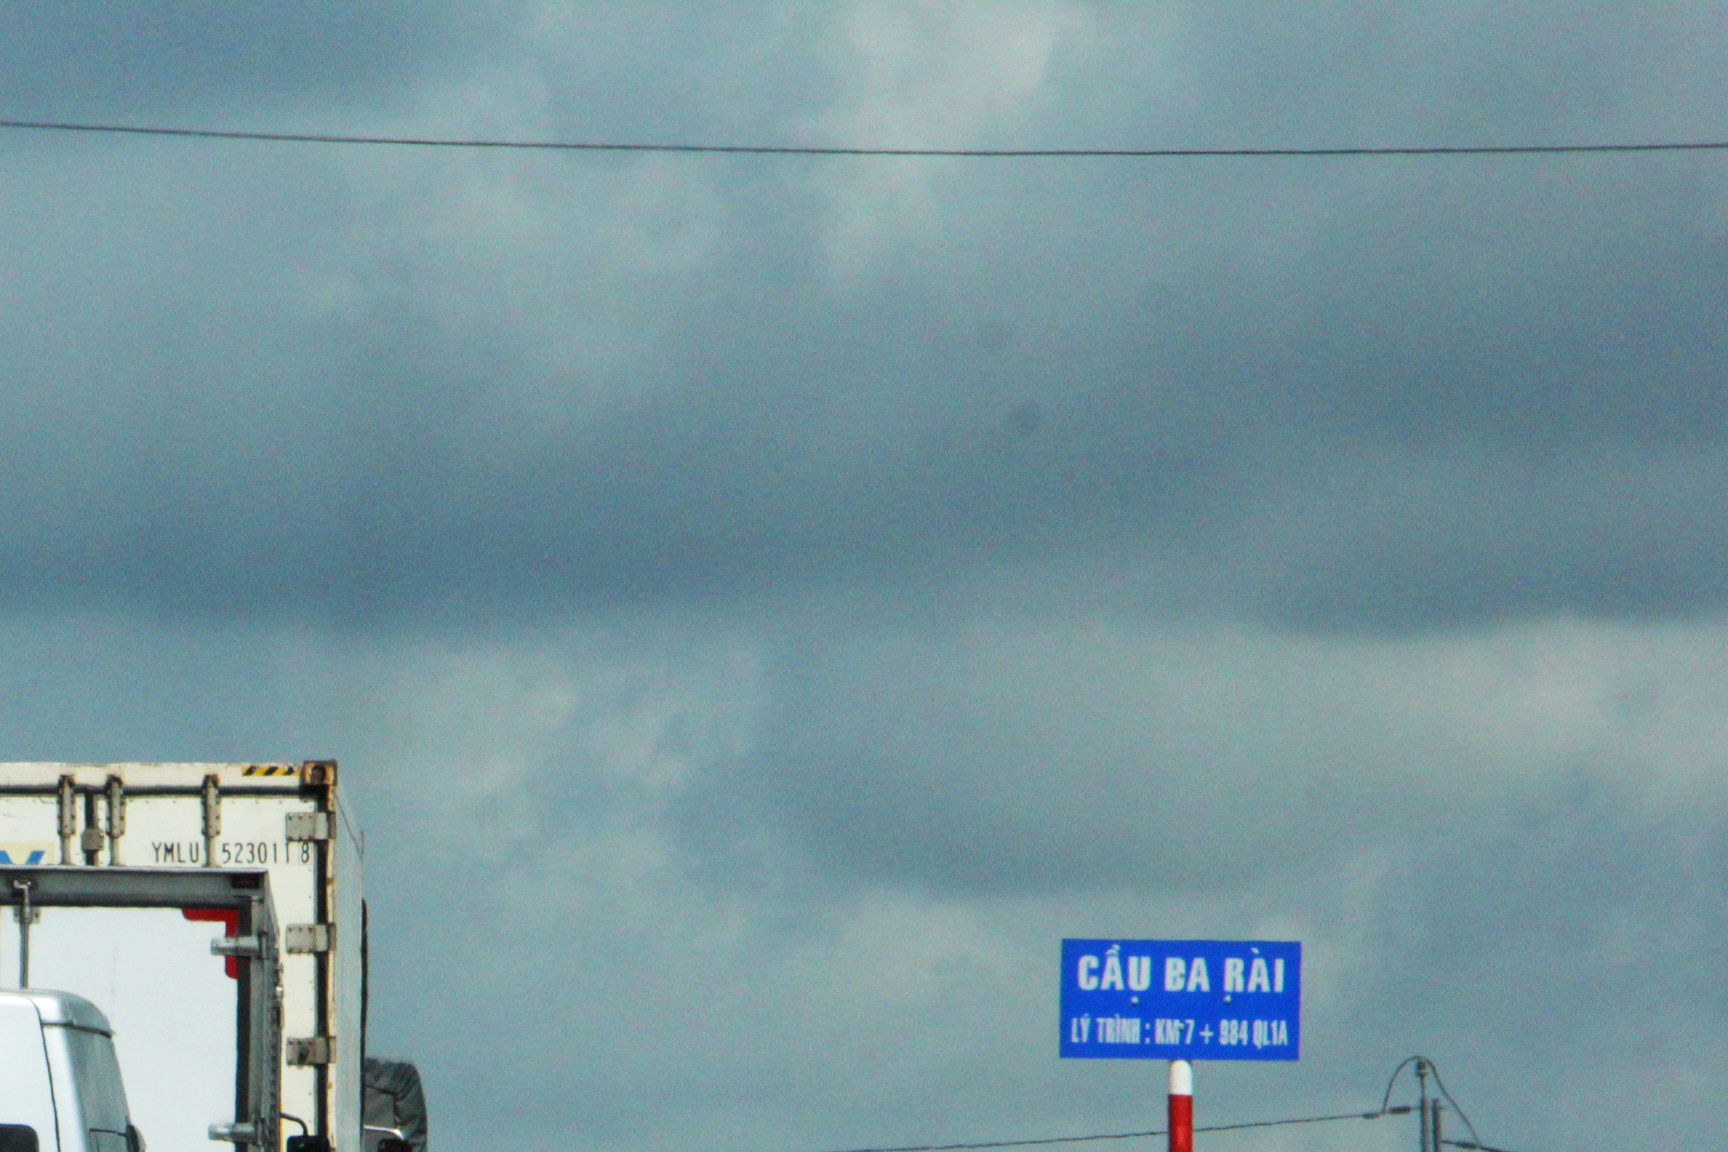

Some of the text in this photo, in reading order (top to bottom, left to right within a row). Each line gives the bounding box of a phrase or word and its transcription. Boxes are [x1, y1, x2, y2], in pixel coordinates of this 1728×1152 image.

[151, 842, 200, 864] YMLU
[222, 842, 290, 864] 523011
[1078, 944, 1284, 993] CẦU BA RÀI
[1071, 1013, 1091, 1043] LÝ
[1096, 1013, 1140, 1044] TRÌNH
[1252, 1019, 1288, 1049] QL1A
